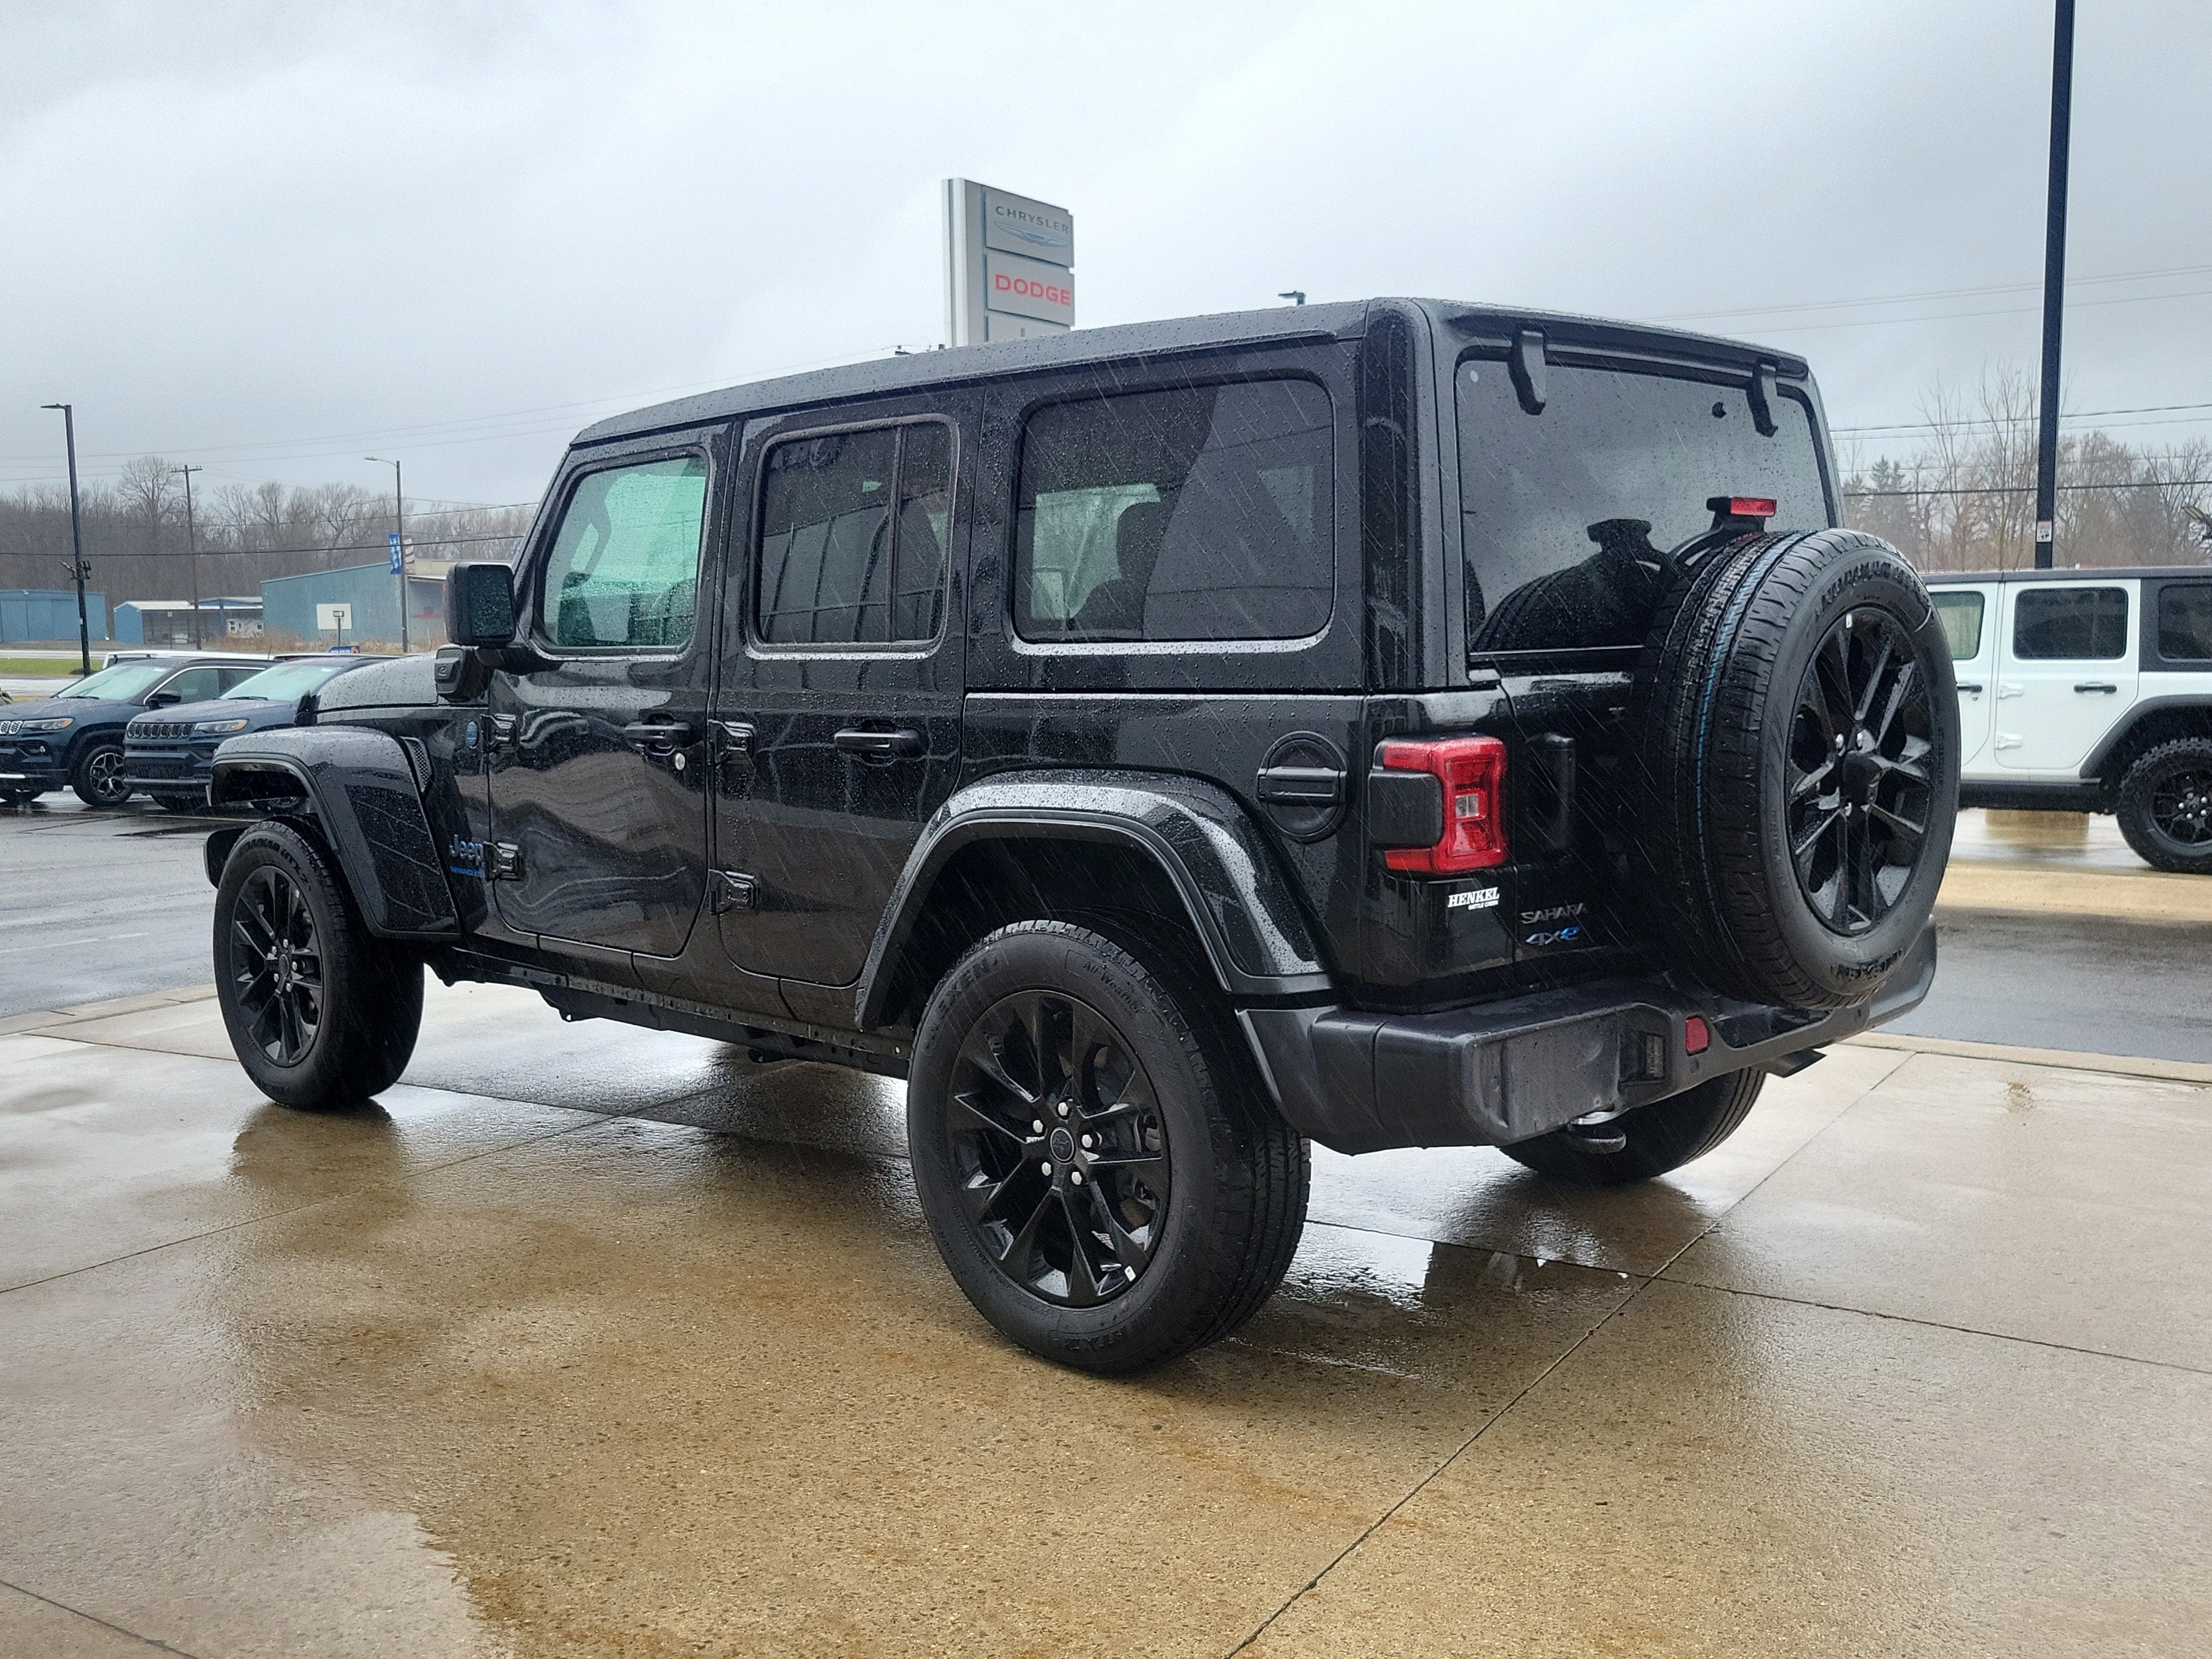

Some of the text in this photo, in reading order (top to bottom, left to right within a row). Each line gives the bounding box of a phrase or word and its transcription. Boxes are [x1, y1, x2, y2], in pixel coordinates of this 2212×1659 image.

[995, 206, 1069, 234] CHRYSLER
[995, 274, 1072, 307] DODGE
[449, 833, 484, 866] Jeep
[1447, 886, 1500, 908] HENKEL
[1519, 902, 1588, 925] SAHARA
